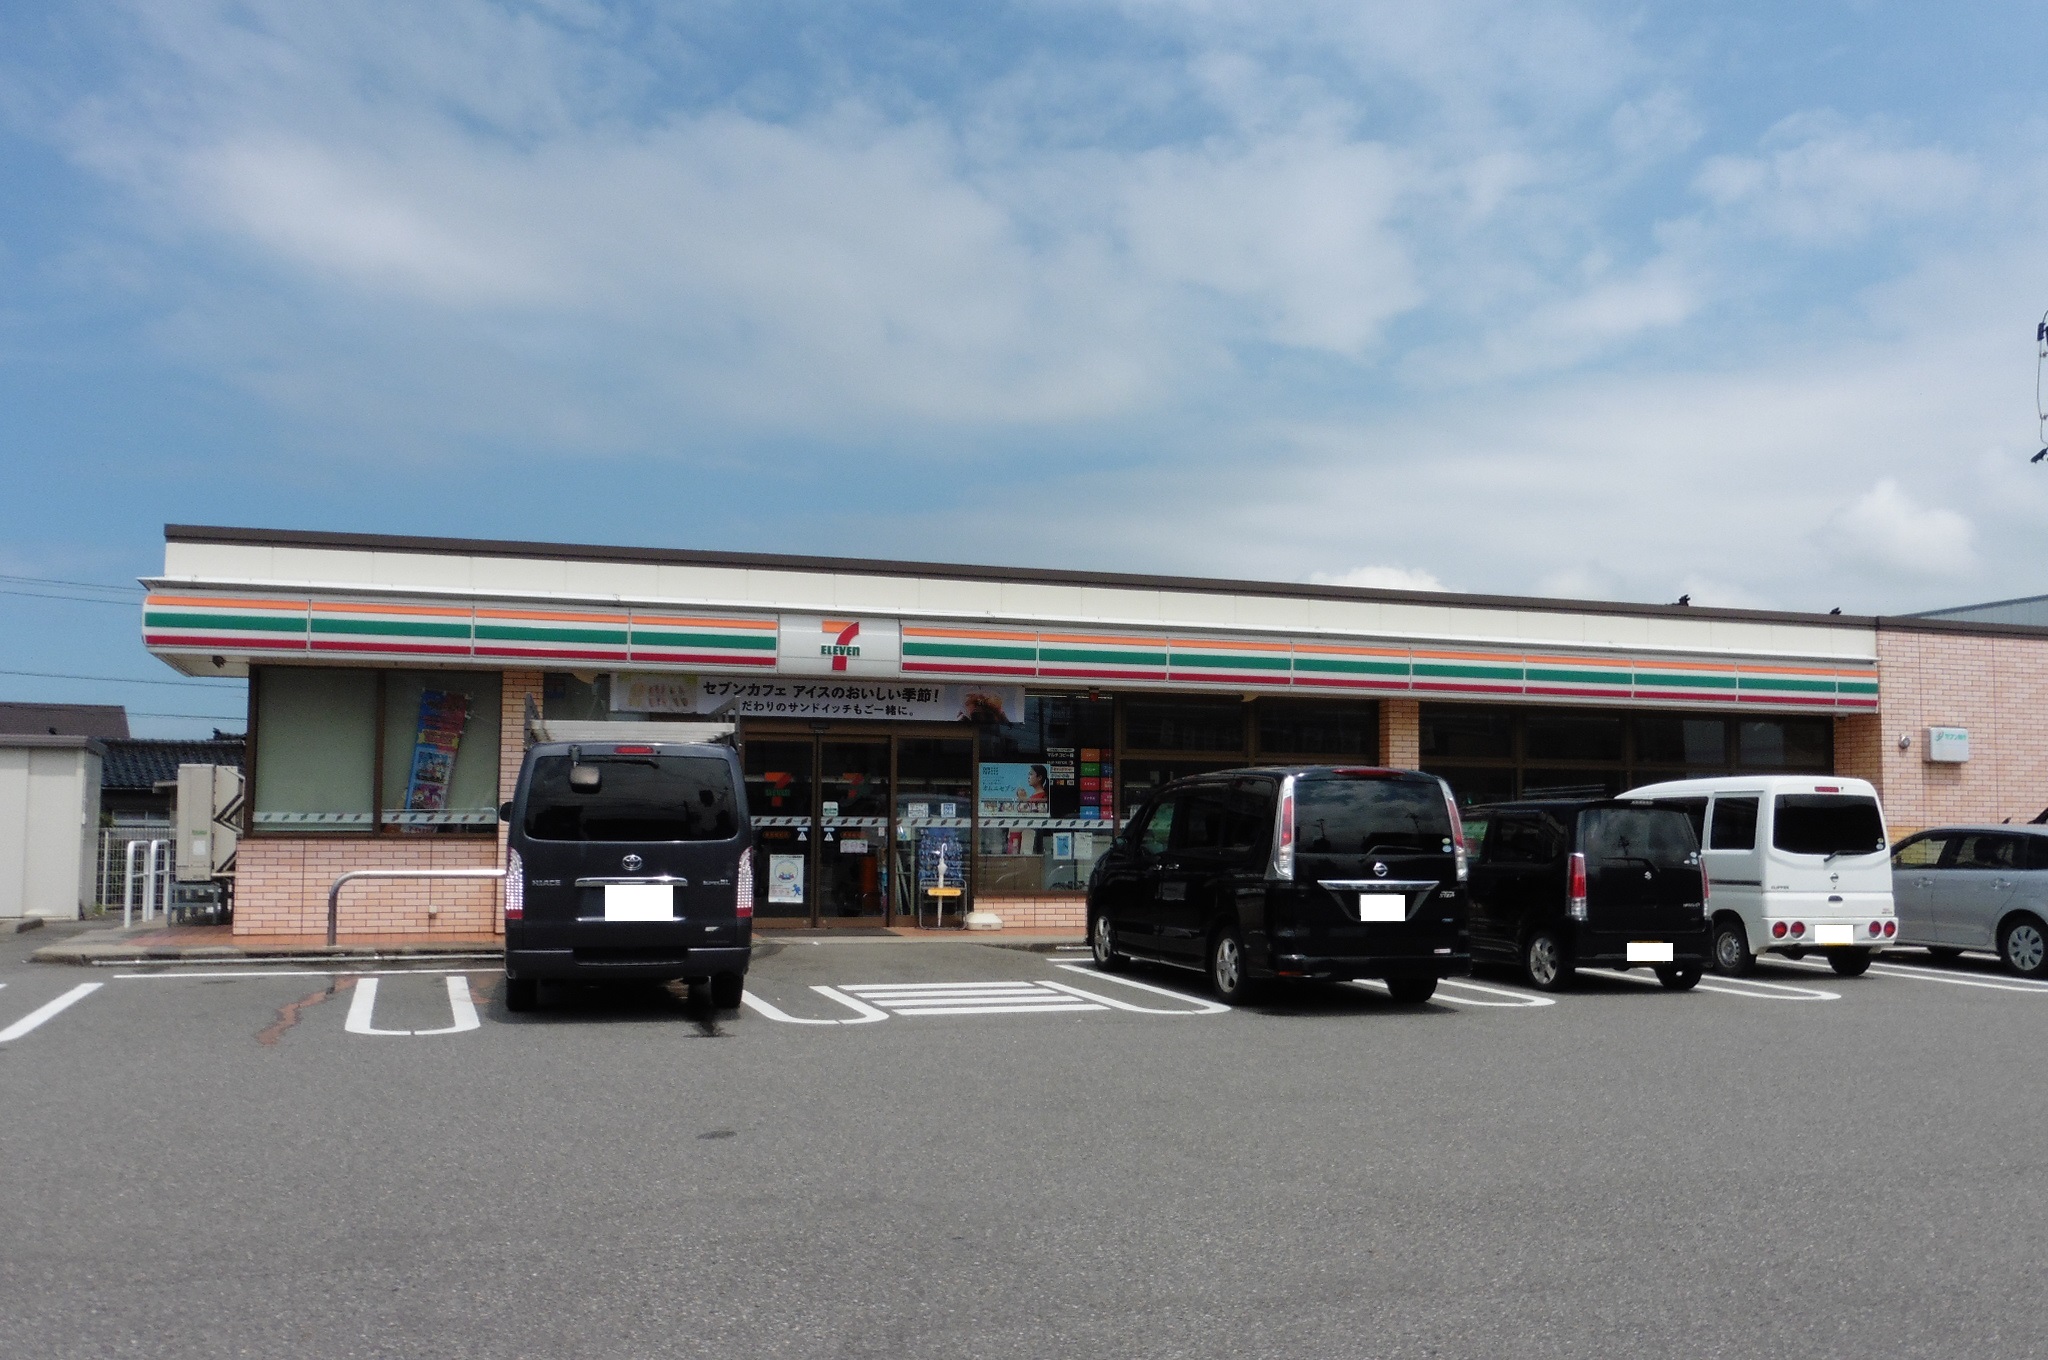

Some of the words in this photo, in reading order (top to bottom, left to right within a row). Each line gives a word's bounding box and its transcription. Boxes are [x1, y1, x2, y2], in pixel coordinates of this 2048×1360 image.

[821, 621, 860, 671] 7
[821, 645, 860, 656] ELEVEN
[703, 681, 787, 697] セブンカフェ
[793, 684, 939, 703] アイスのおいしい季節!
[733, 700, 914, 717] だわりのサンドイッチもご一緒に。
